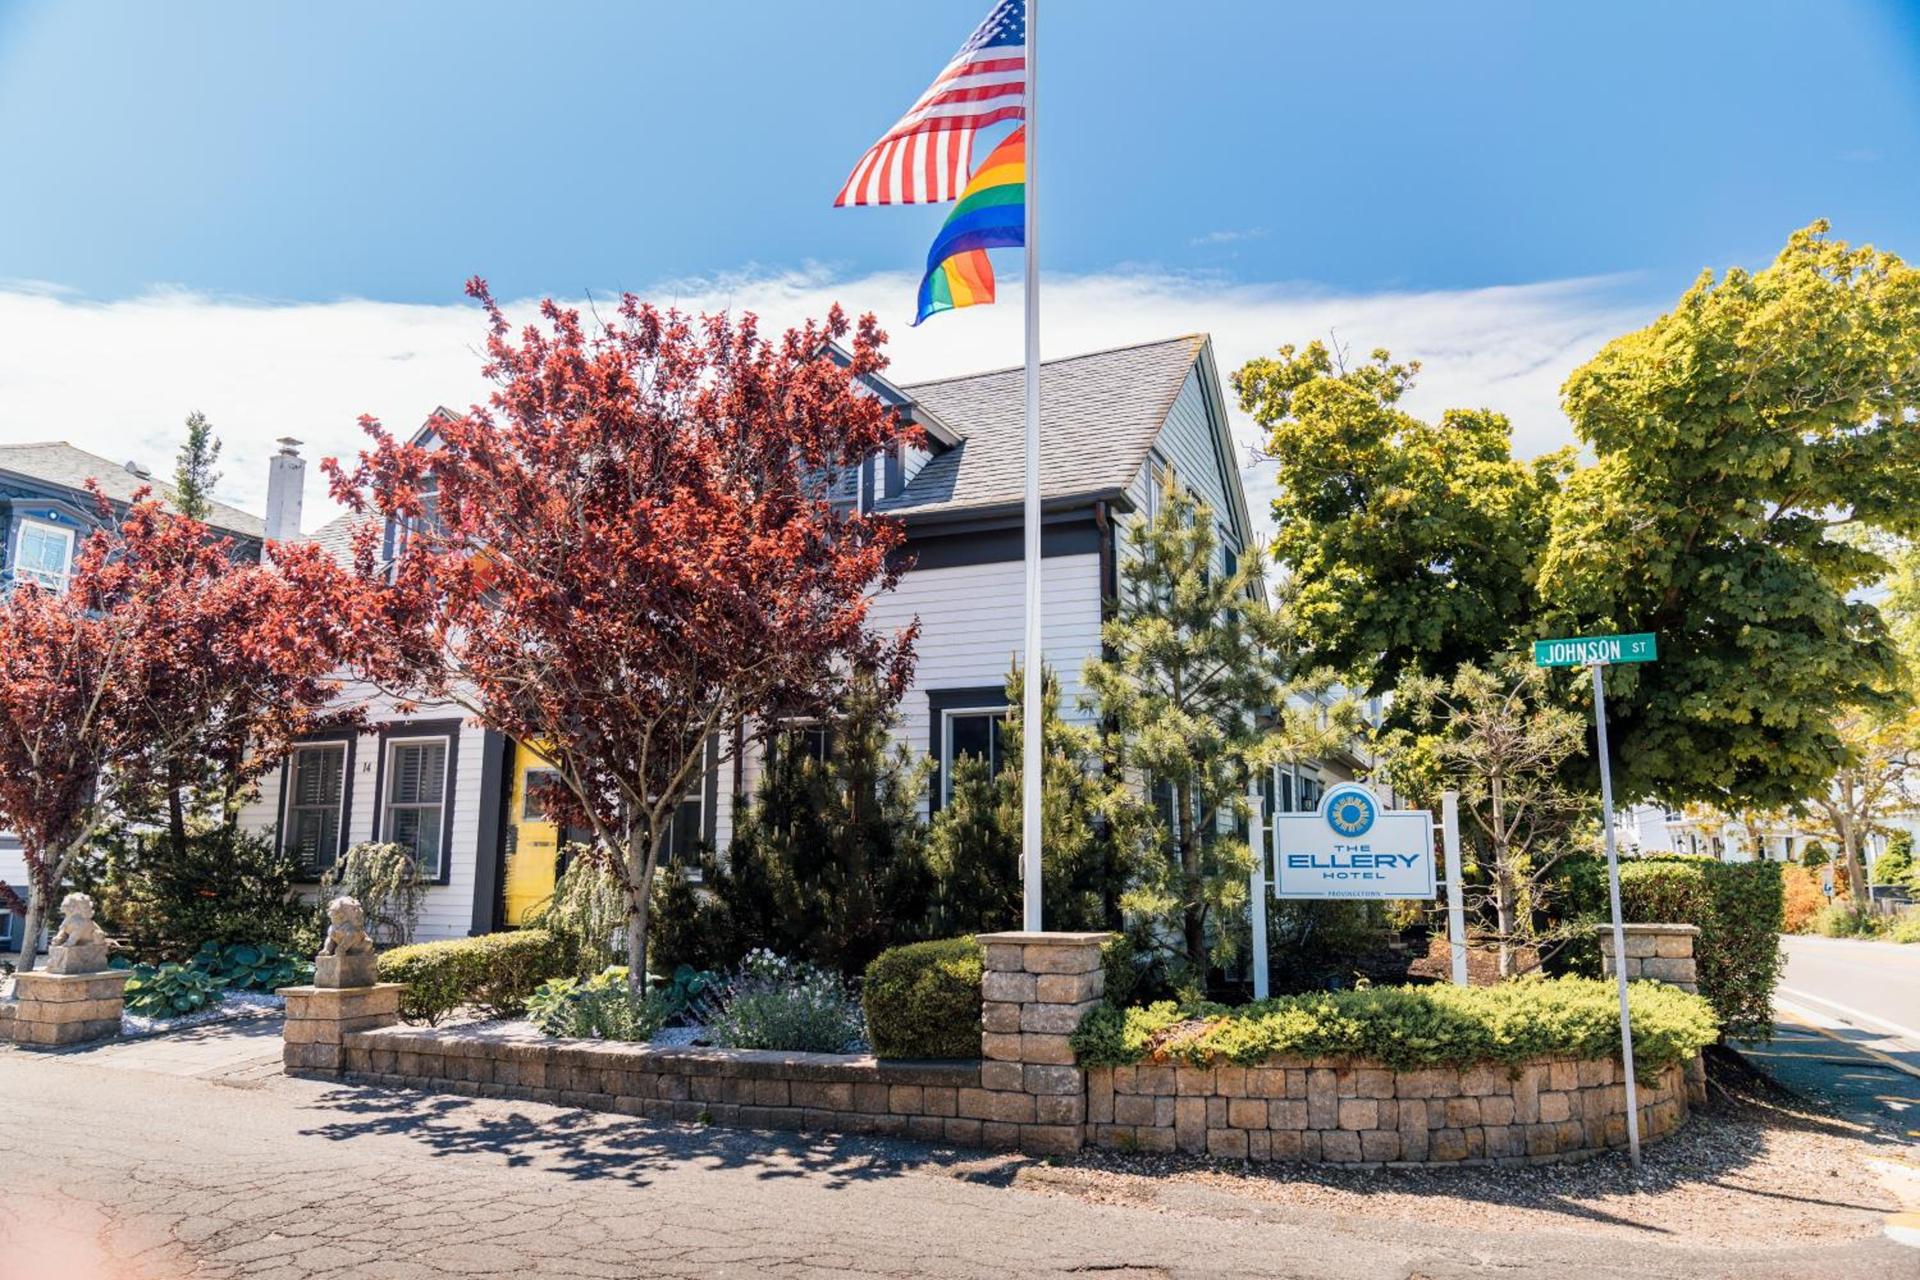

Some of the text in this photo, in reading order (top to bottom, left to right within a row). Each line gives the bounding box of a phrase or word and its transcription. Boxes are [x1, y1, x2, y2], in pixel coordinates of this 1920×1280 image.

[1545, 640, 1646, 663] JOHNSON ST
[1289, 854, 1420, 868] ELLERY
[1323, 872, 1386, 880] HOTEL
